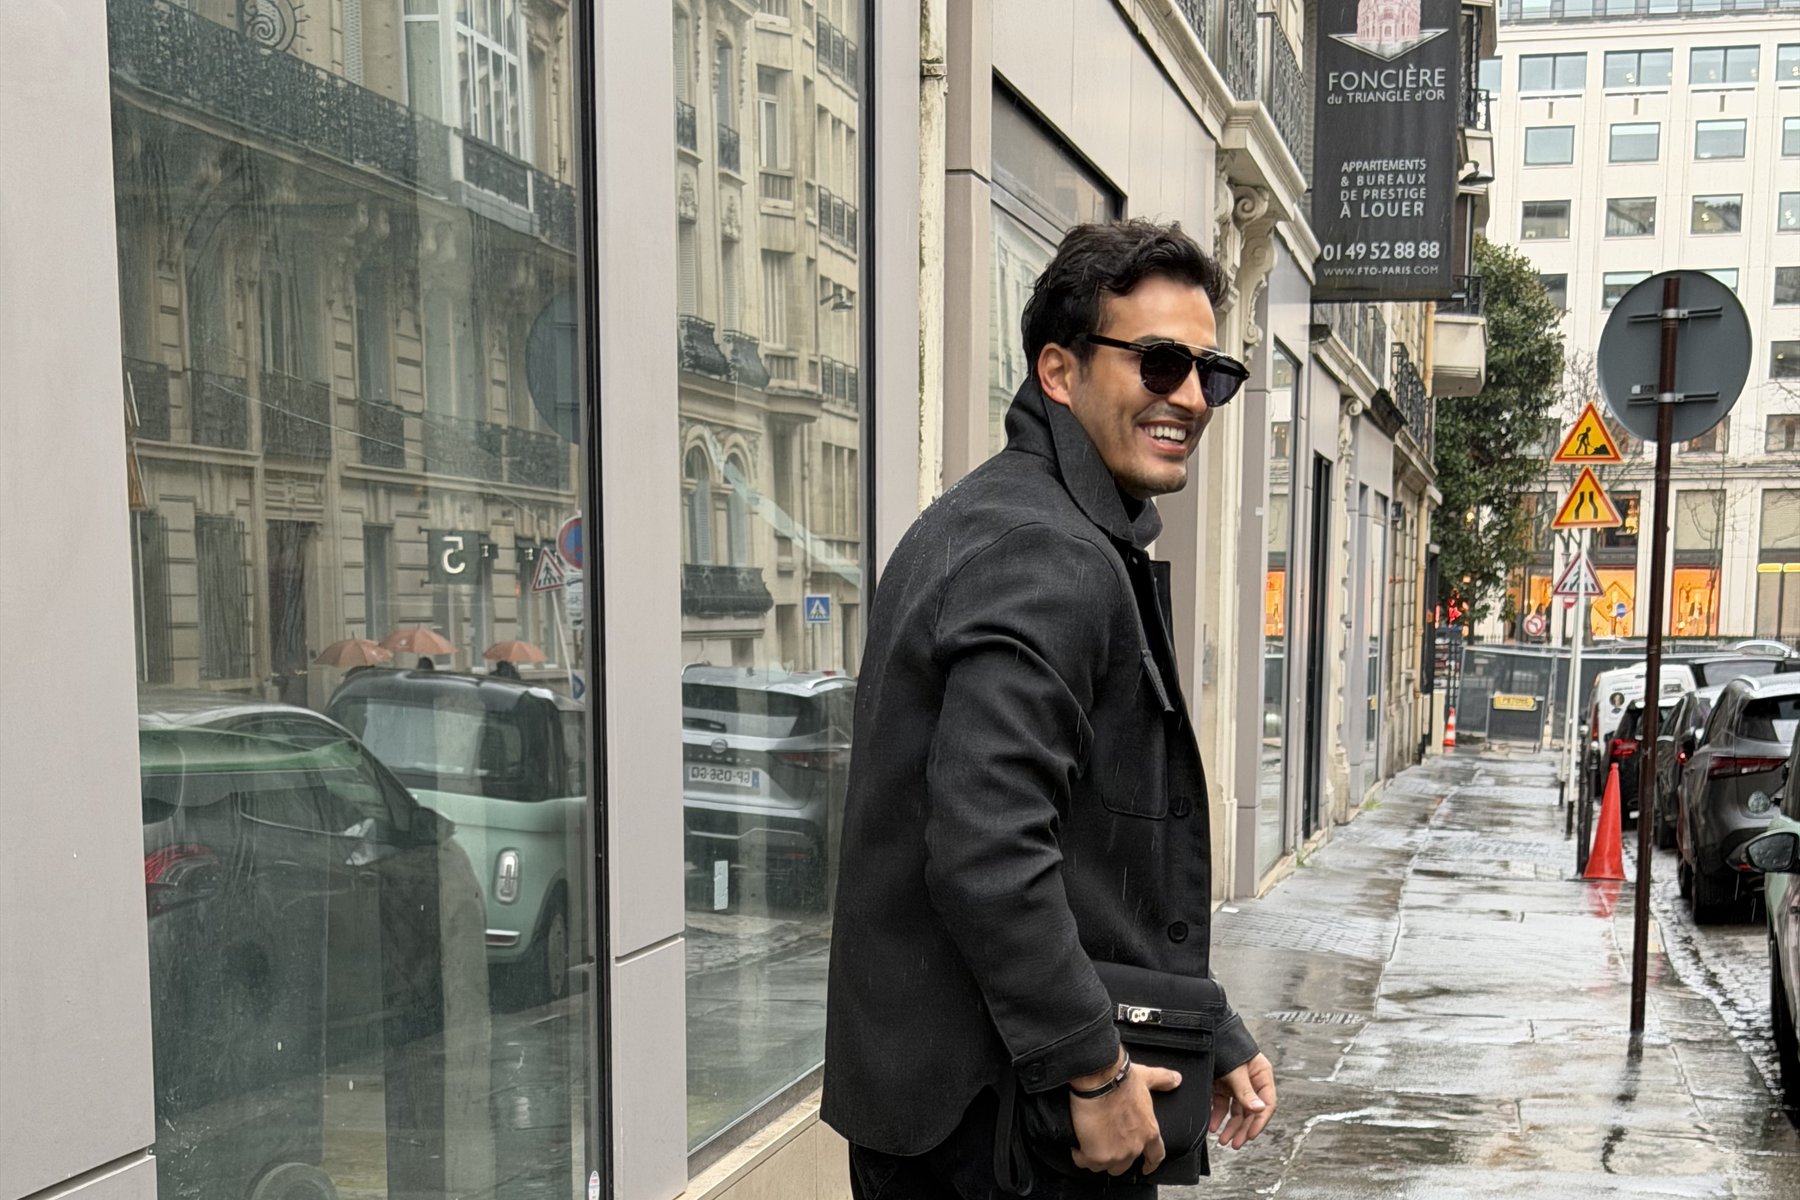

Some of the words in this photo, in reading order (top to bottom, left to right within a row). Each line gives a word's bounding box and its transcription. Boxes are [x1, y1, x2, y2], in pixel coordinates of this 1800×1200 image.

[1328, 64, 1446, 91] FONCIÈRE
[1327, 94, 1342, 104] du
[1347, 90, 1410, 103] TRIANGLE
[1415, 90, 1445, 101] d'OR
[1341, 159, 1427, 173] APPARTEMENTS
[1341, 176, 1349, 187] &
[1357, 174, 1426, 186] BUREAUX
[1340, 190, 1357, 201] DE
[1363, 188, 1426, 200] PRESTIGE
[1340, 203, 1350, 218] À
[1361, 202, 1424, 218] LOUER
[1323, 244, 1341, 261] 01
[1345, 243, 1366, 260] 49
[1370, 243, 1390, 260] 52
[1394, 242, 1414, 259] 88
[1418, 241, 1440, 258] 88
